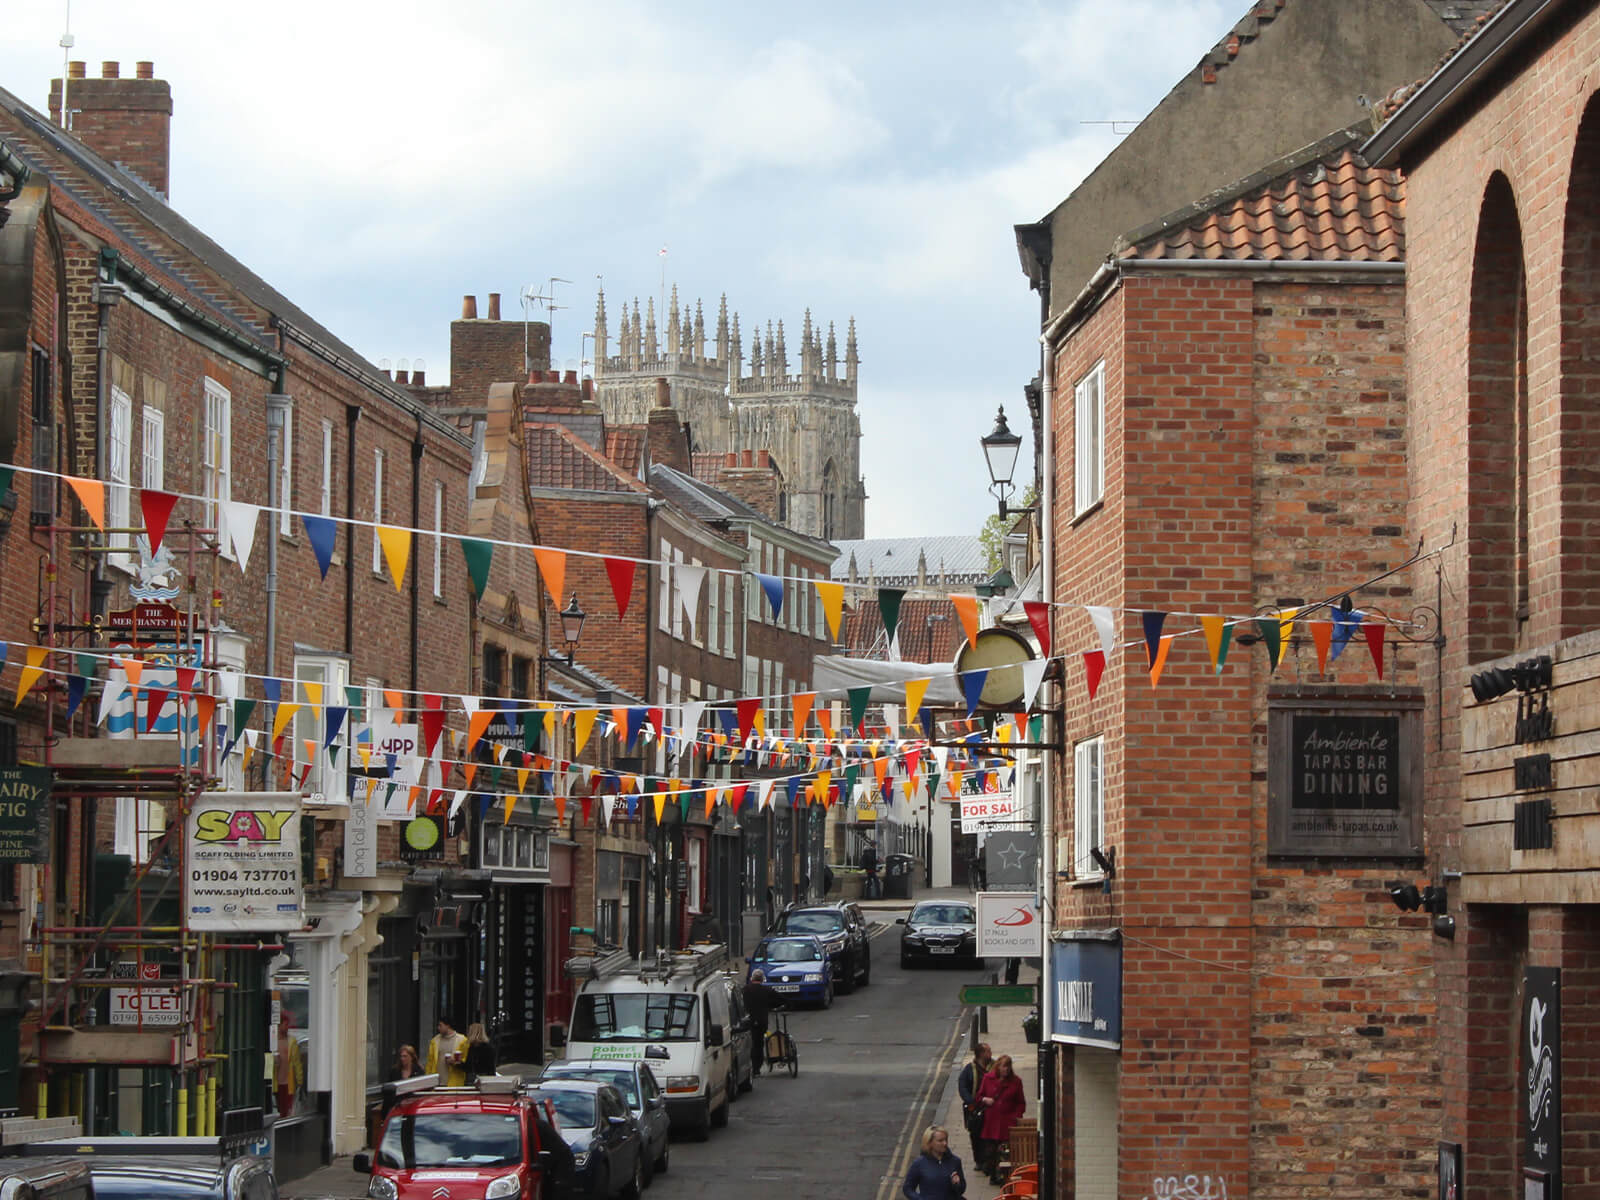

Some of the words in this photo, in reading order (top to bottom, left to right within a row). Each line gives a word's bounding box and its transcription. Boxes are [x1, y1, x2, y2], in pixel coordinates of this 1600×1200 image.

[144, 609, 162, 617] THE
[170, 619, 187, 627] HAL
[488, 724, 525, 736] MUMBA
[489, 738, 525, 752] LOUNG
[1303, 728, 1388, 751] Ambiente
[1304, 754, 1351, 769] TAPAS
[1357, 754, 1387, 769] BAR
[3, 771, 22, 779] THE
[1303, 773, 1388, 794] DINING
[0, 782, 42, 801] AIRY
[351, 802, 366, 826] sall
[963, 805, 988, 816] FOR
[194, 809, 296, 841] SAY
[1292, 821, 1399, 833] ambiente-tapas.co.uk
[351, 827, 366, 846] tall
[0, 849, 31, 858] ODDER
[351, 847, 369, 876] long
[192, 870, 238, 881] 01904
[243, 870, 297, 881] 737701
[194, 887, 296, 897] www.sayltd.co.uk
[117, 994, 142, 1010] TO
[149, 994, 181, 1010] LET
[524, 966, 535, 1031] LOUNGE
[112, 1013, 143, 1023] 0190
[592, 1045, 637, 1053] Robert
